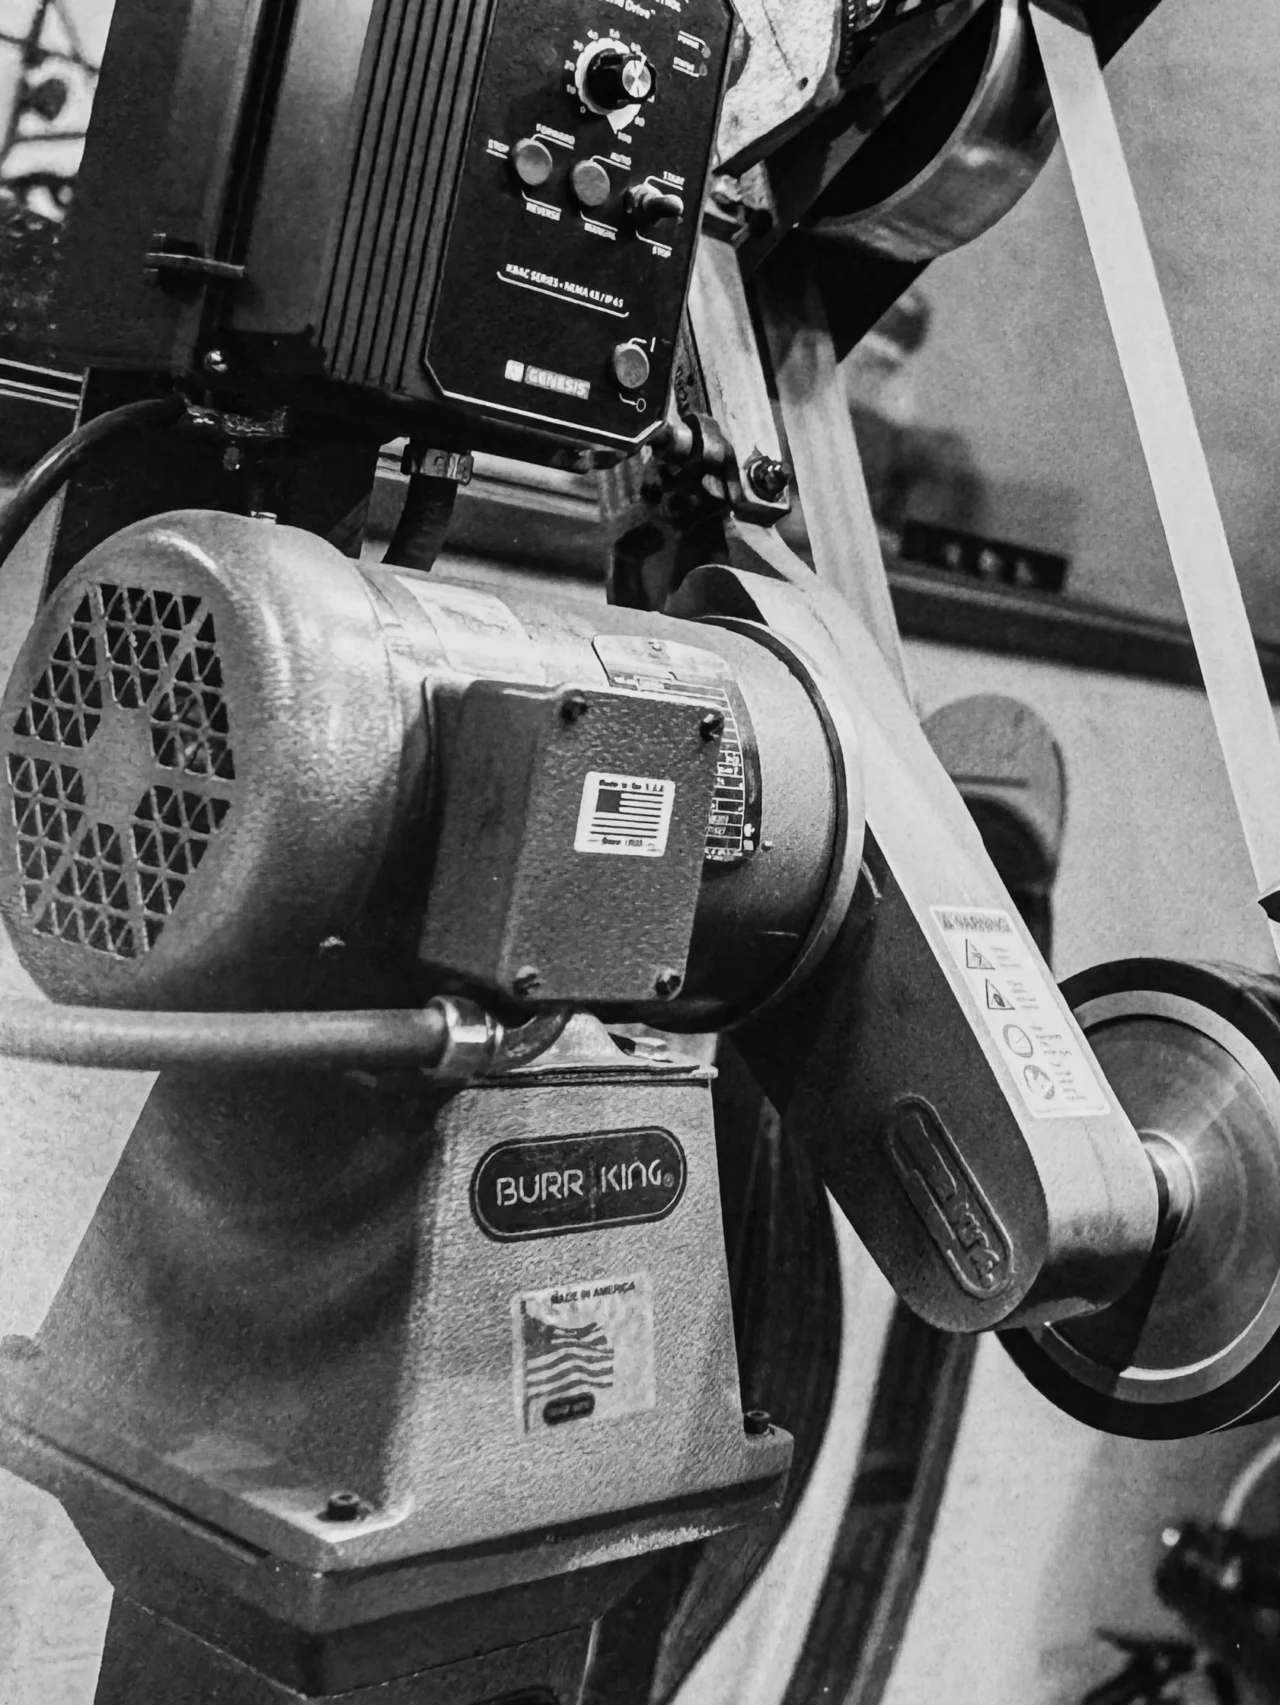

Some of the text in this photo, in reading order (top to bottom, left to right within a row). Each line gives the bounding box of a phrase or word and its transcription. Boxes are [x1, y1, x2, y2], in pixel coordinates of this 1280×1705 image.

[488, 138, 510, 153] STOP
[536, 122, 575, 146] FORWARD
[610, 152, 632, 166] AUTO
[525, 202, 561, 221] REVERSE
[652, 245, 672, 259] STOP
[530, 270, 559, 289] SERIES
[563, 281, 589, 298] NEMA
[527, 368, 590, 398] GENESIS
[496, 1169, 584, 1206] BURR
[550, 1280, 636, 1305] MADE IN AMERICA
